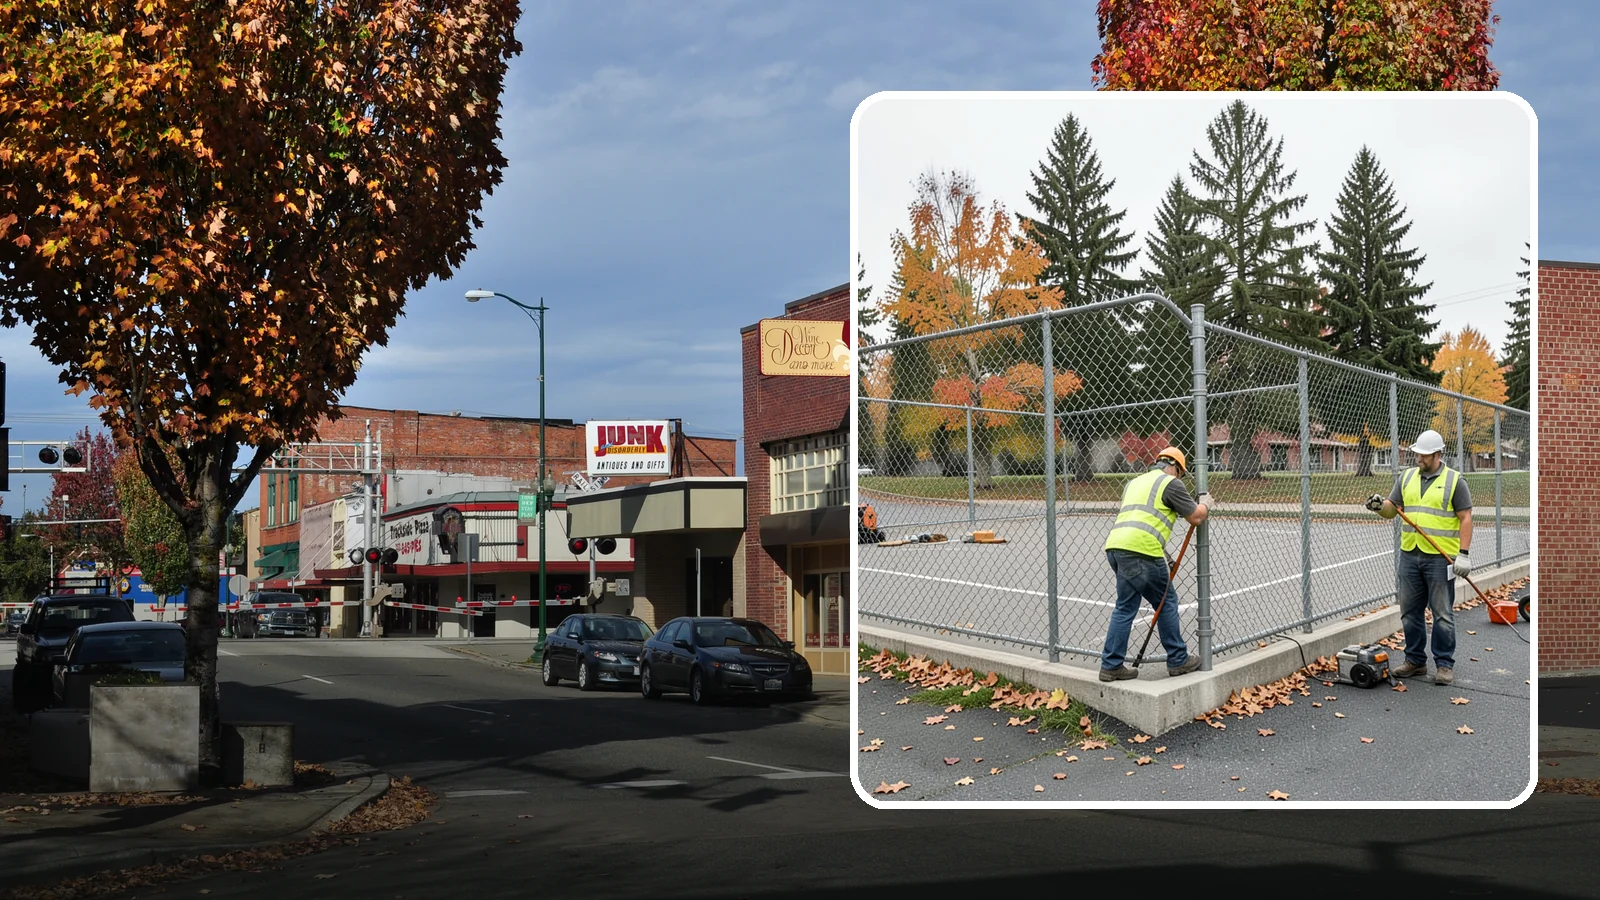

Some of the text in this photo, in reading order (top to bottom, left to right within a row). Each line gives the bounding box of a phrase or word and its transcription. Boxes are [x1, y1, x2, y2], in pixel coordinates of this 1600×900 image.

[596, 425, 665, 457] JUNK
[607, 446, 646, 454] DISORDERLY
[597, 460, 665, 470] ANTIQUES AND GIFTS
[573, 473, 588, 490] RAIL
